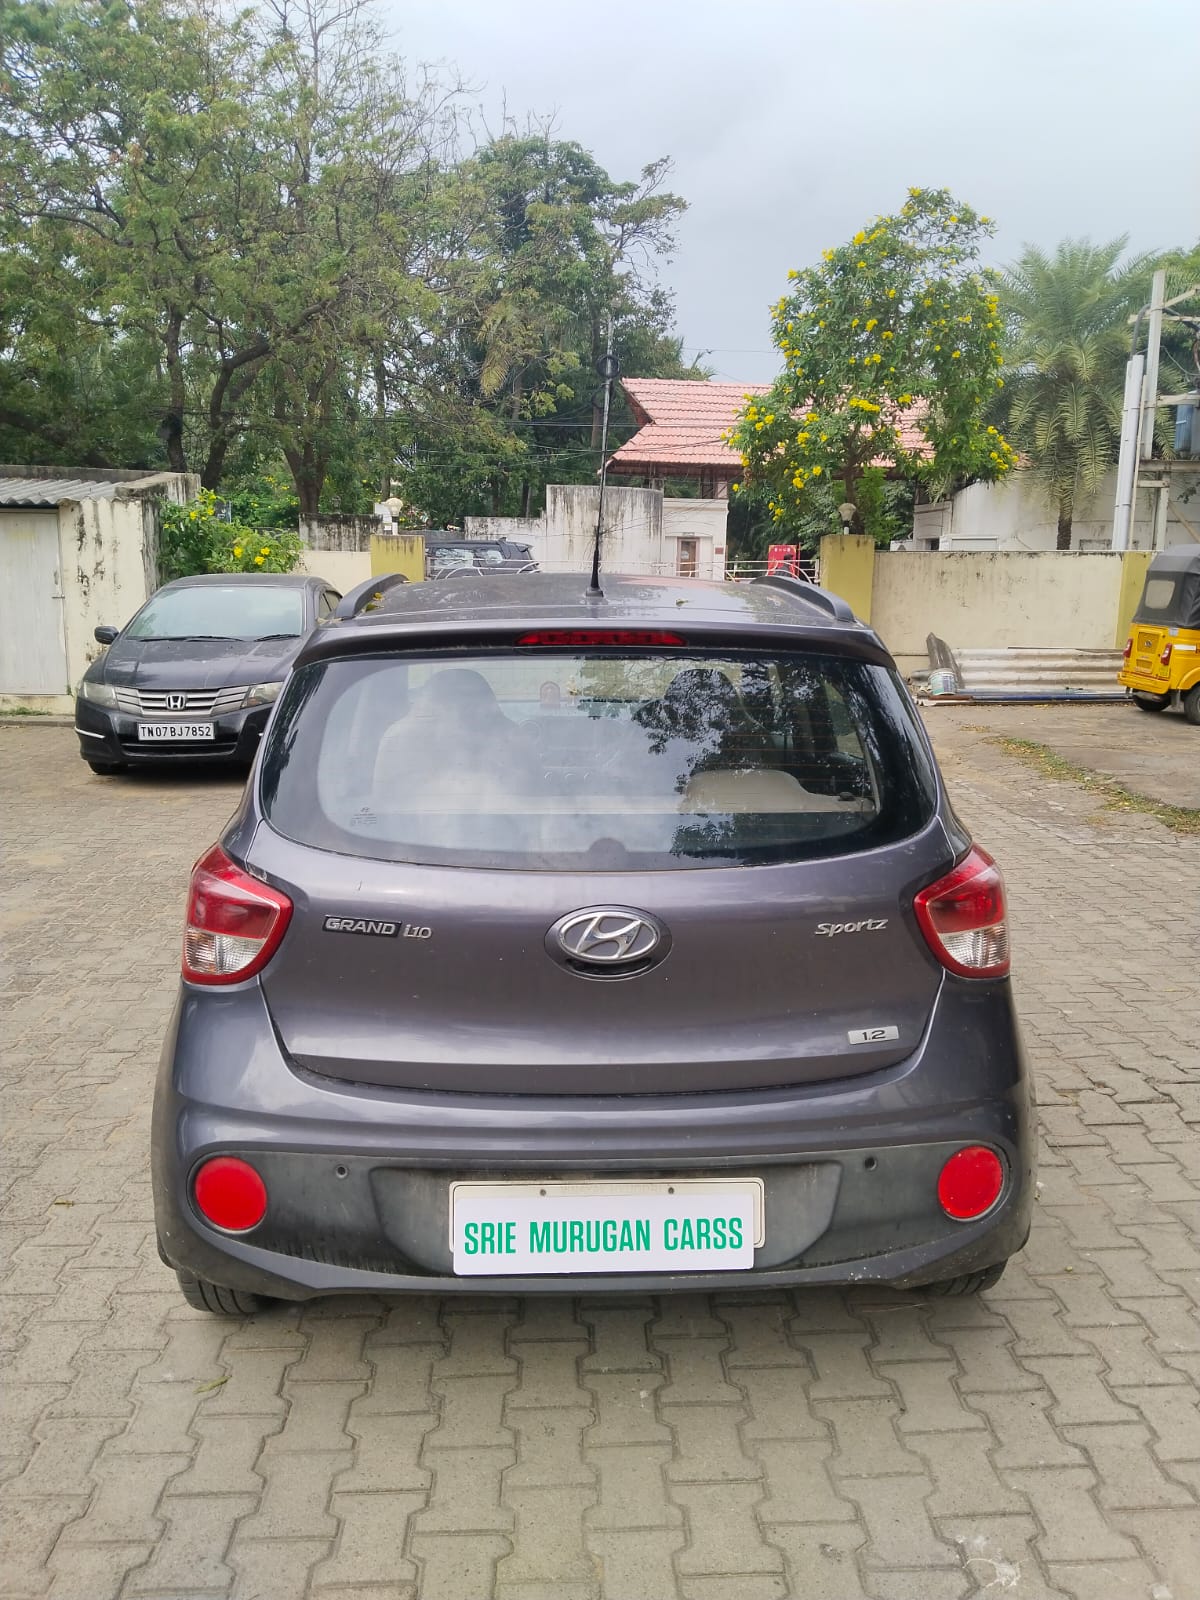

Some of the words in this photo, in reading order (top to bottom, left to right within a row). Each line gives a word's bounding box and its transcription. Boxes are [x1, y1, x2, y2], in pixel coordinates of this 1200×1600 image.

[140, 726, 212, 737] TN07BJ7852
[325, 917, 396, 935] GRAND
[403, 924, 432, 939] i10
[815, 918, 889, 937] Sportz
[861, 1029, 887, 1041] 1.2
[464, 1221, 517, 1255] SRIE
[529, 1219, 651, 1254] MURUGAN
[663, 1217, 743, 1251] CARSS
